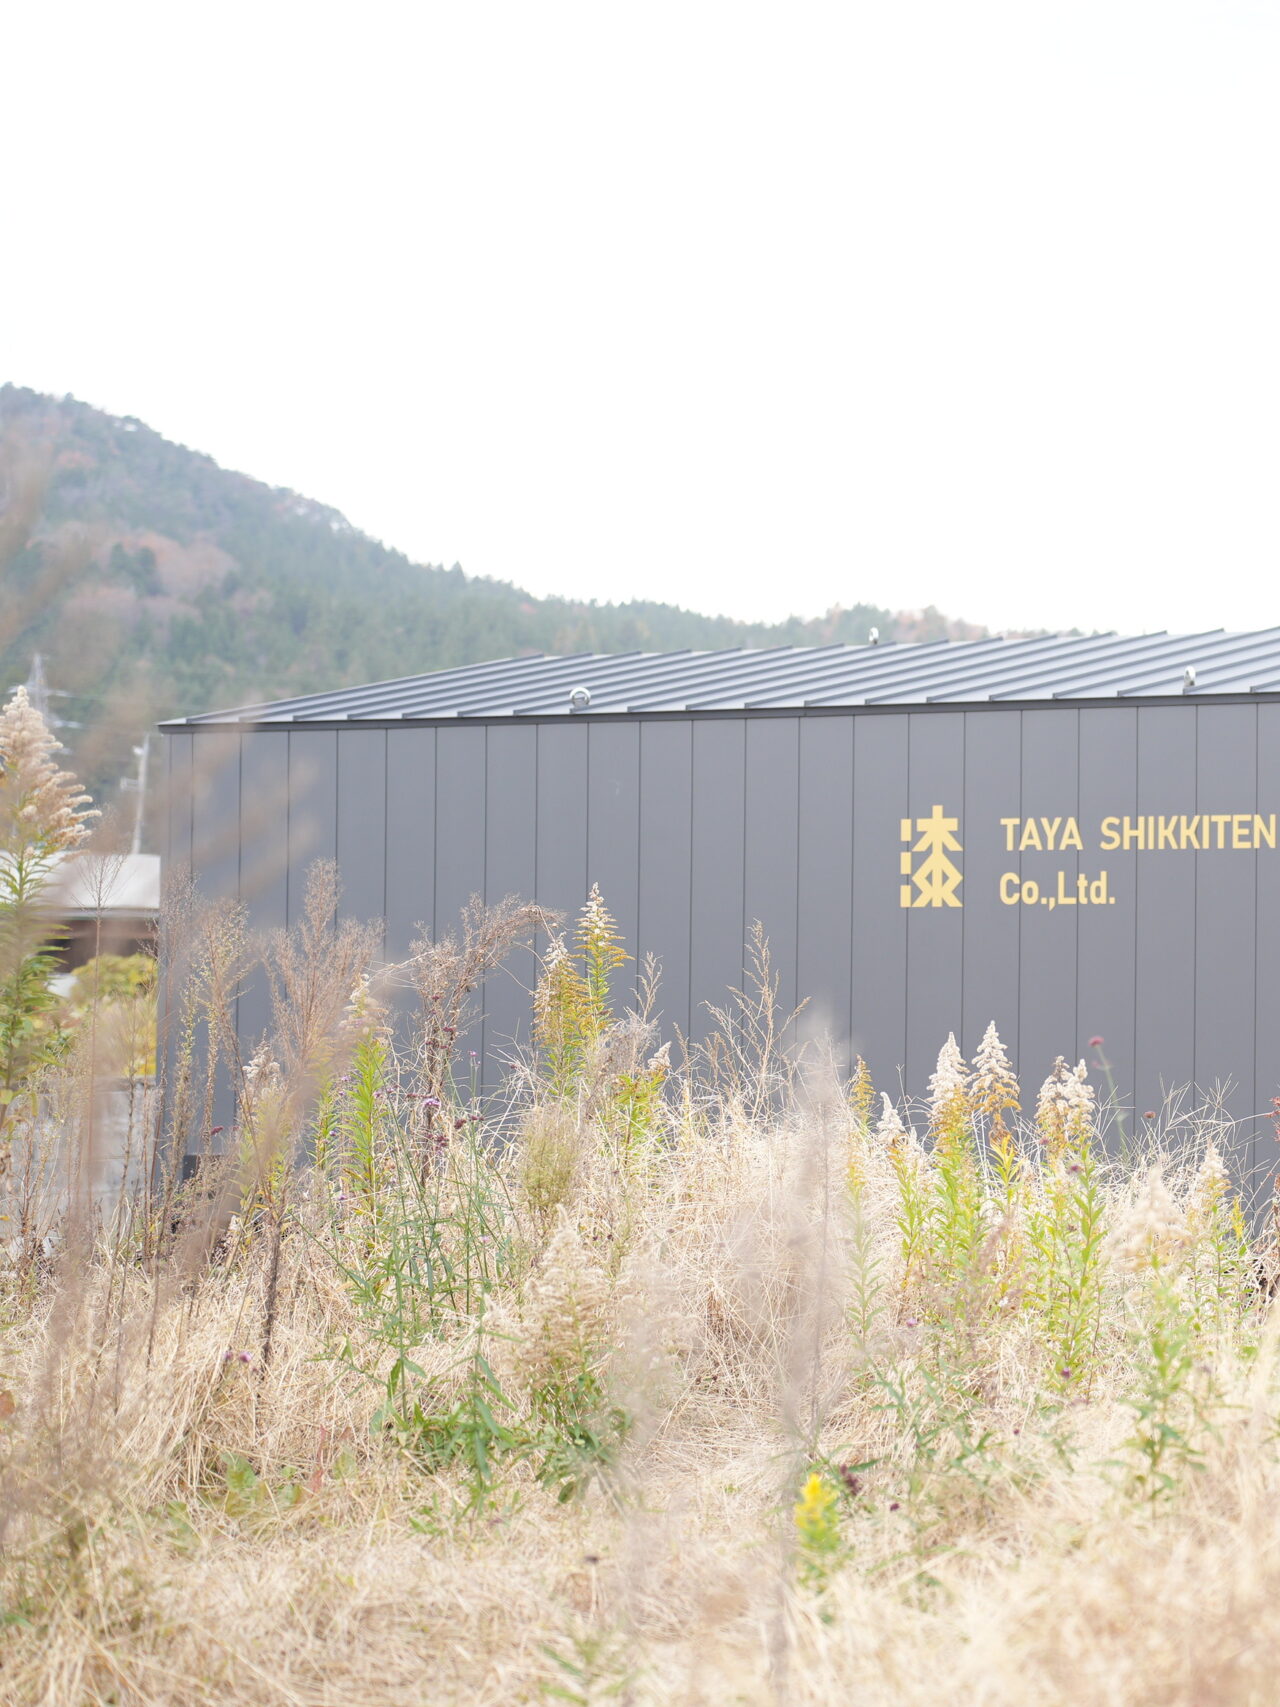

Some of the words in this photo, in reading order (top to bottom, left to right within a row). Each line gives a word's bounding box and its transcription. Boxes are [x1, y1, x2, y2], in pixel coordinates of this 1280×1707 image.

[1000, 817, 1083, 851] TAYA
[1100, 814, 1277, 850] SHIKKITEN
[1000, 871, 1116, 911] Co.,Ltd.
